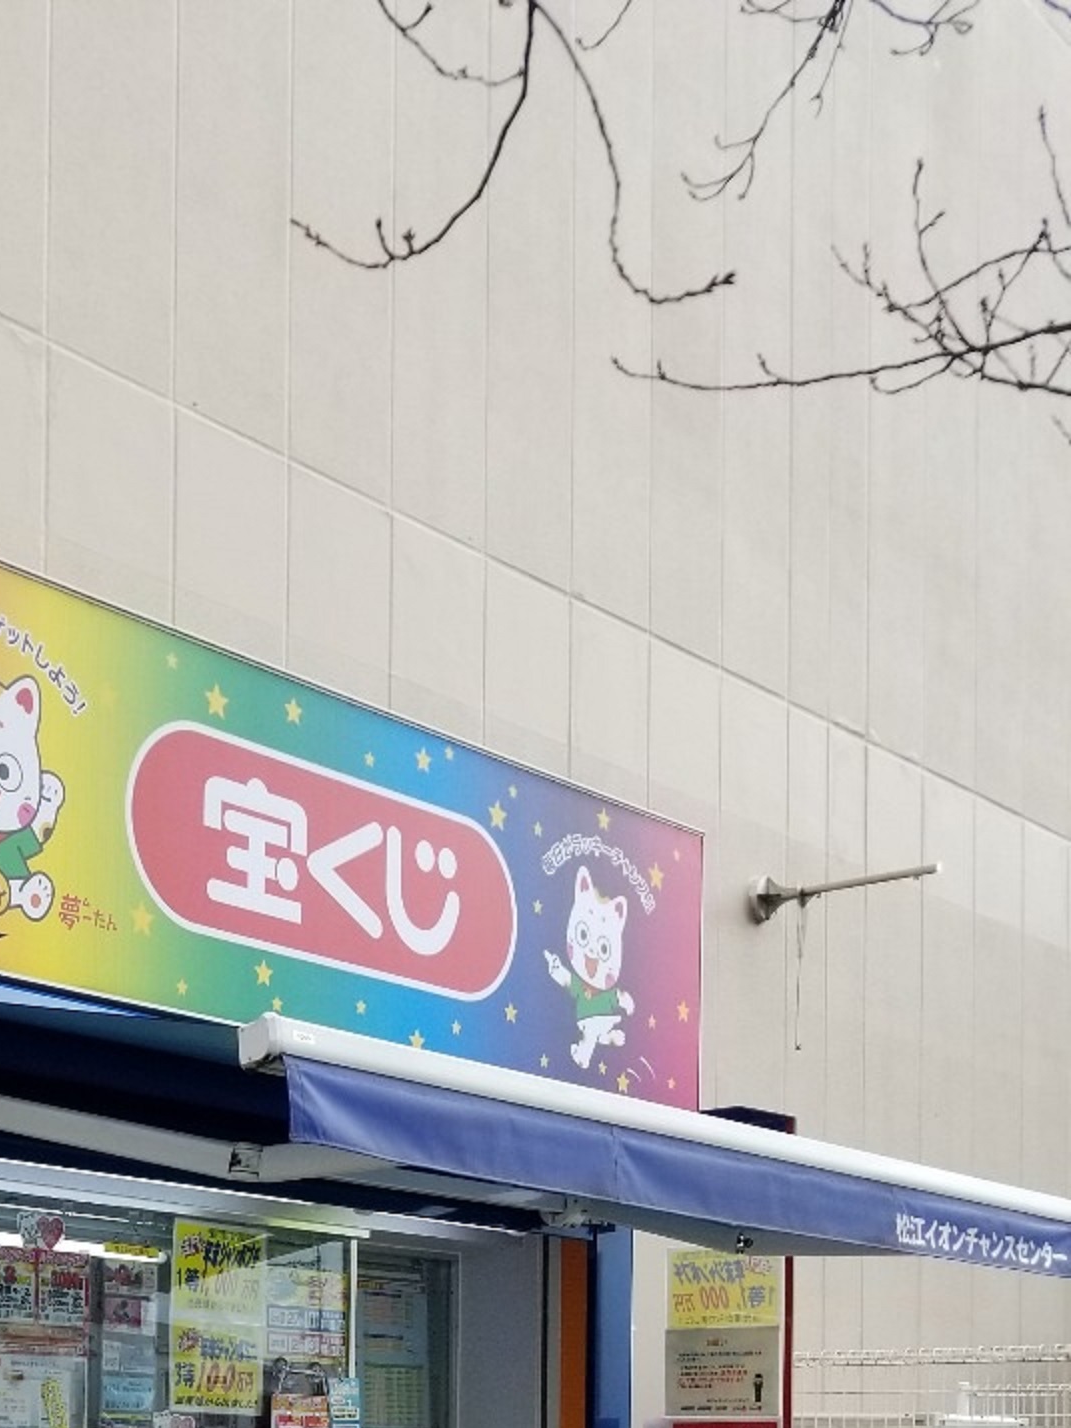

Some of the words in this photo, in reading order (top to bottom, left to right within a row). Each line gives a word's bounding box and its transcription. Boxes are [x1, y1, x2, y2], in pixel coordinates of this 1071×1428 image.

[203, 776, 459, 955] 宝くじ
[896, 1212, 1067, 1268] 松江イオンチャンスセンター
